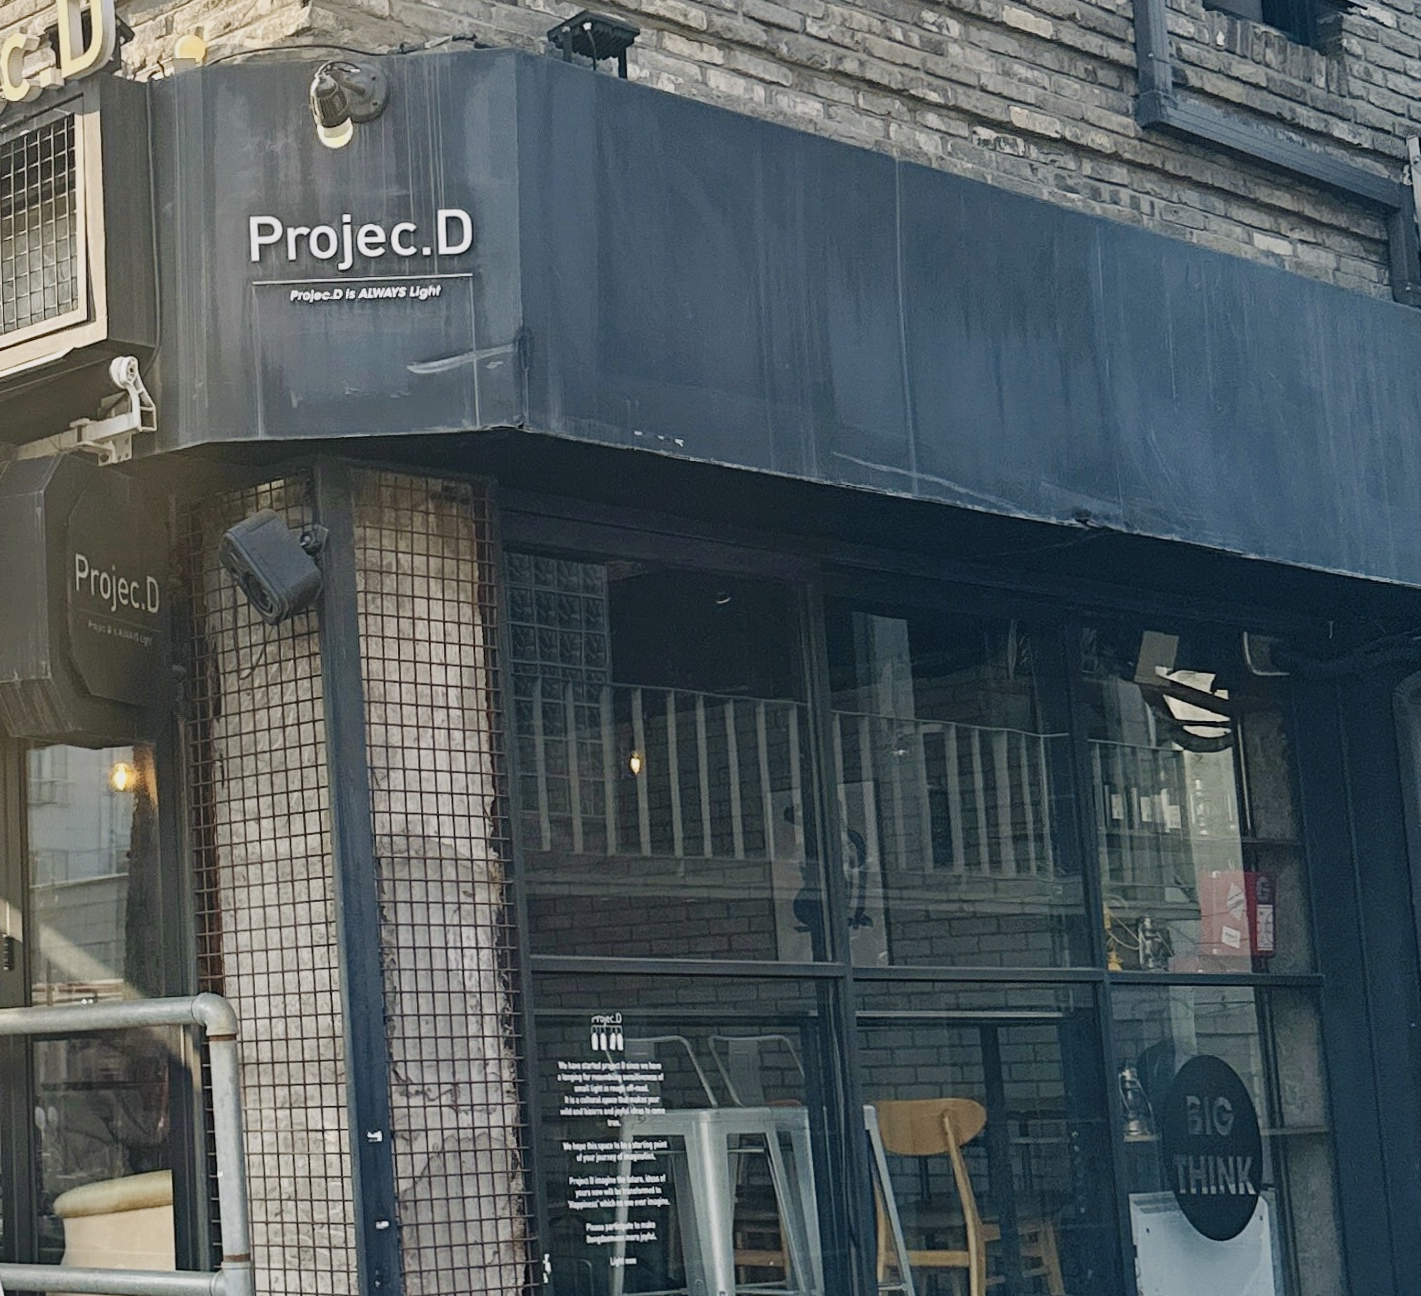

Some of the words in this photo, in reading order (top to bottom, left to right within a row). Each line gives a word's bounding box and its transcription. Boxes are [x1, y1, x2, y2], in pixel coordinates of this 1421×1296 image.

[249, 209, 473, 270] Projec.D
[357, 286, 406, 299] ALWAYS
[409, 285, 441, 301] Light
[75, 553, 159, 613] Projec.D
[1185, 1095, 1235, 1136] BIG
[1174, 1154, 1256, 1195] THINK
